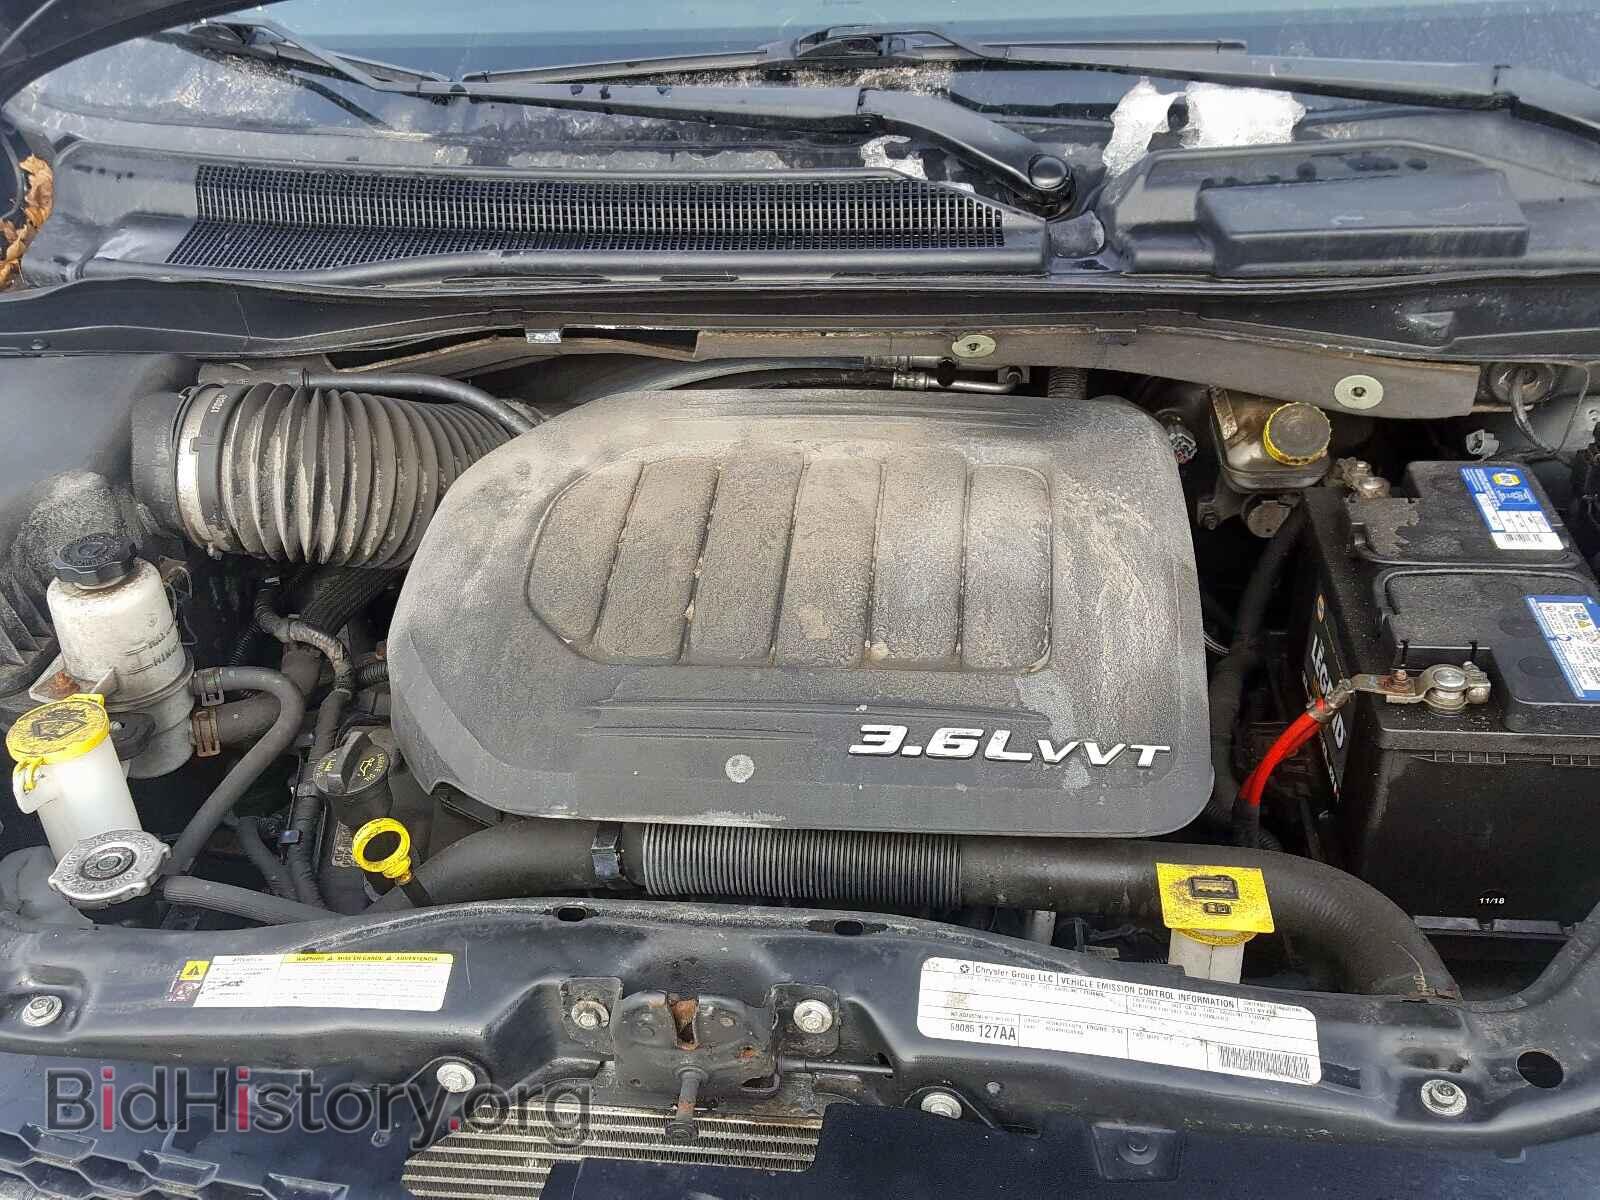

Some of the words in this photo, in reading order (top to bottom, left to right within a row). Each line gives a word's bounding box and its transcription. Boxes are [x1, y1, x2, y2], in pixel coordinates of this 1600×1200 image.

[1479, 897, 1505, 905] 11/18
[975, 964, 1010, 977] Chrysler
[1011, 969, 1036, 981] Group
[1038, 973, 1054, 983] LLC
[1060, 976, 1094, 989] VEHICLE
[1096, 982, 1136, 994] EMISSION
[1138, 987, 1176, 1000] CONTROL
[1178, 992, 1236, 1009] INFORMATION
[978, 1025, 1017, 1041] 127AA
